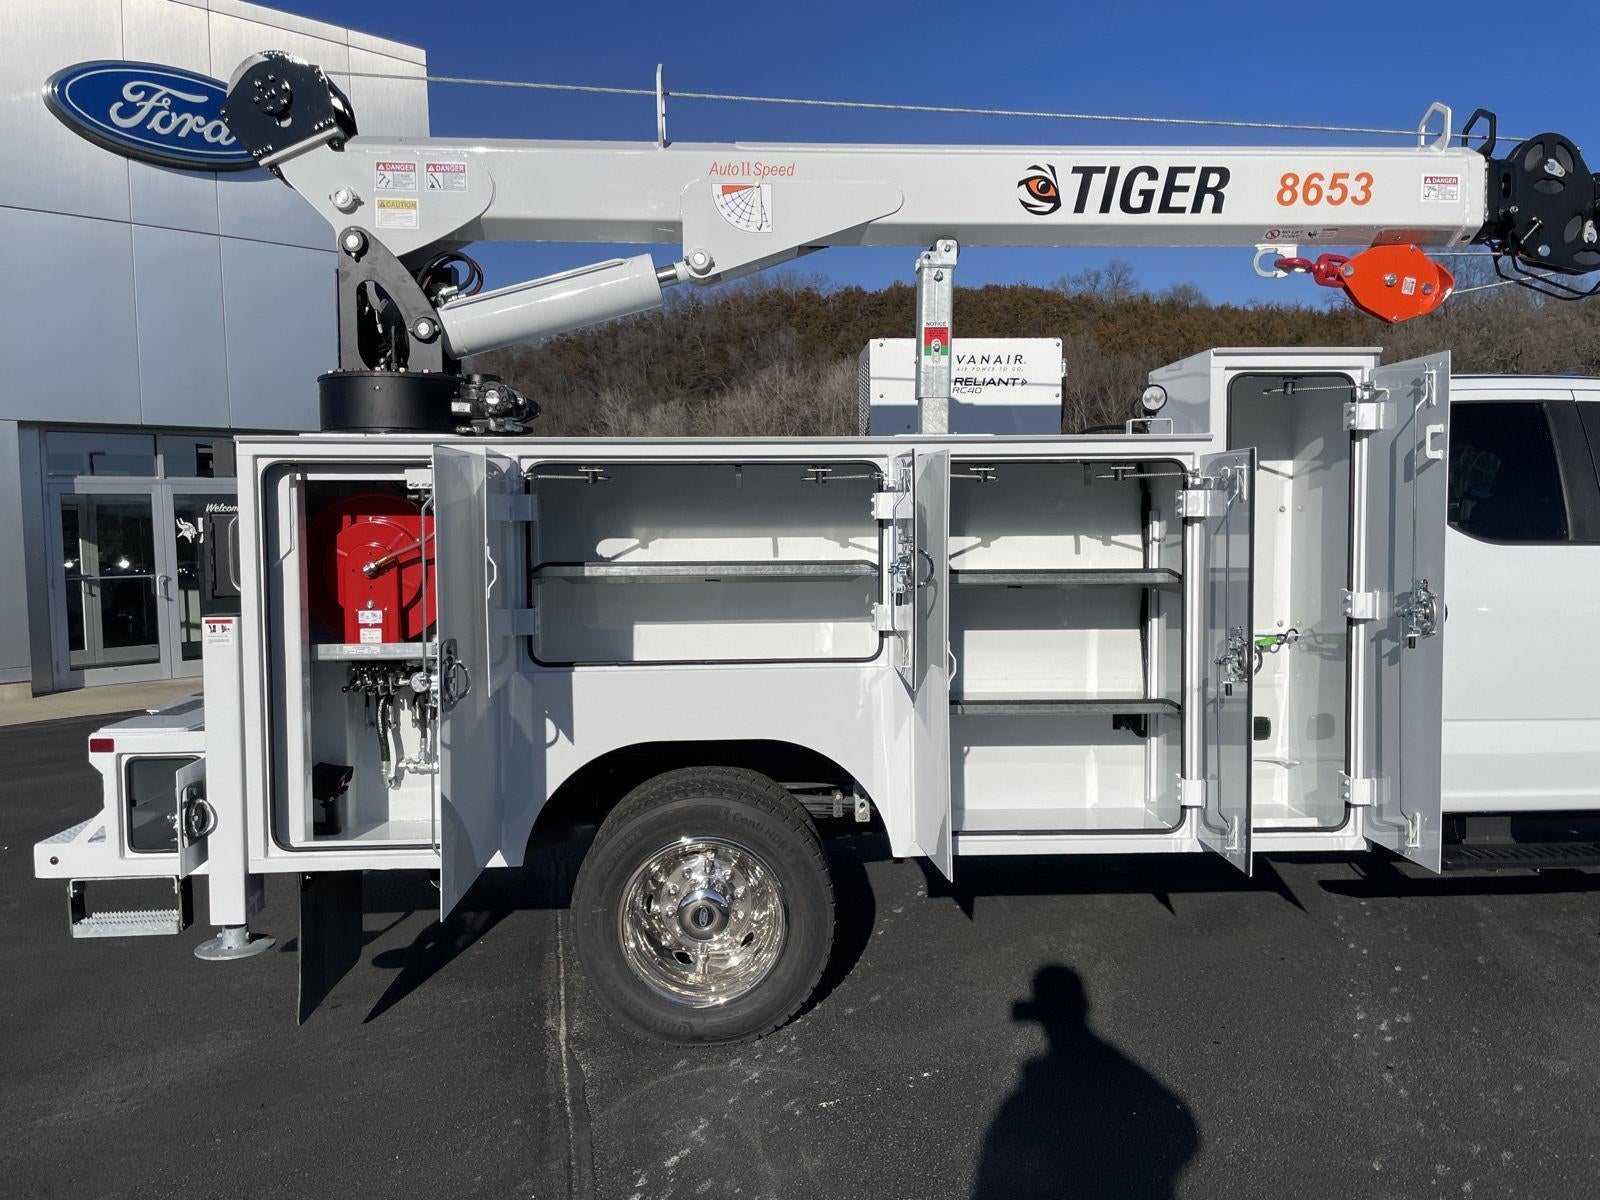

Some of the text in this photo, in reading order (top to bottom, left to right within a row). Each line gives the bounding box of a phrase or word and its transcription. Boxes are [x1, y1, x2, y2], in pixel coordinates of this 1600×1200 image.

[385, 163, 415, 171] DANGER
[709, 161, 796, 180] Auto II Speed
[1071, 165, 1231, 214] TIGER
[1276, 172, 1374, 206] 8653
[384, 200, 417, 209] CAUTION
[953, 377, 1020, 387] RELIANT
[952, 386, 983, 394] RC40
[205, 503, 240, 513] Welcom
